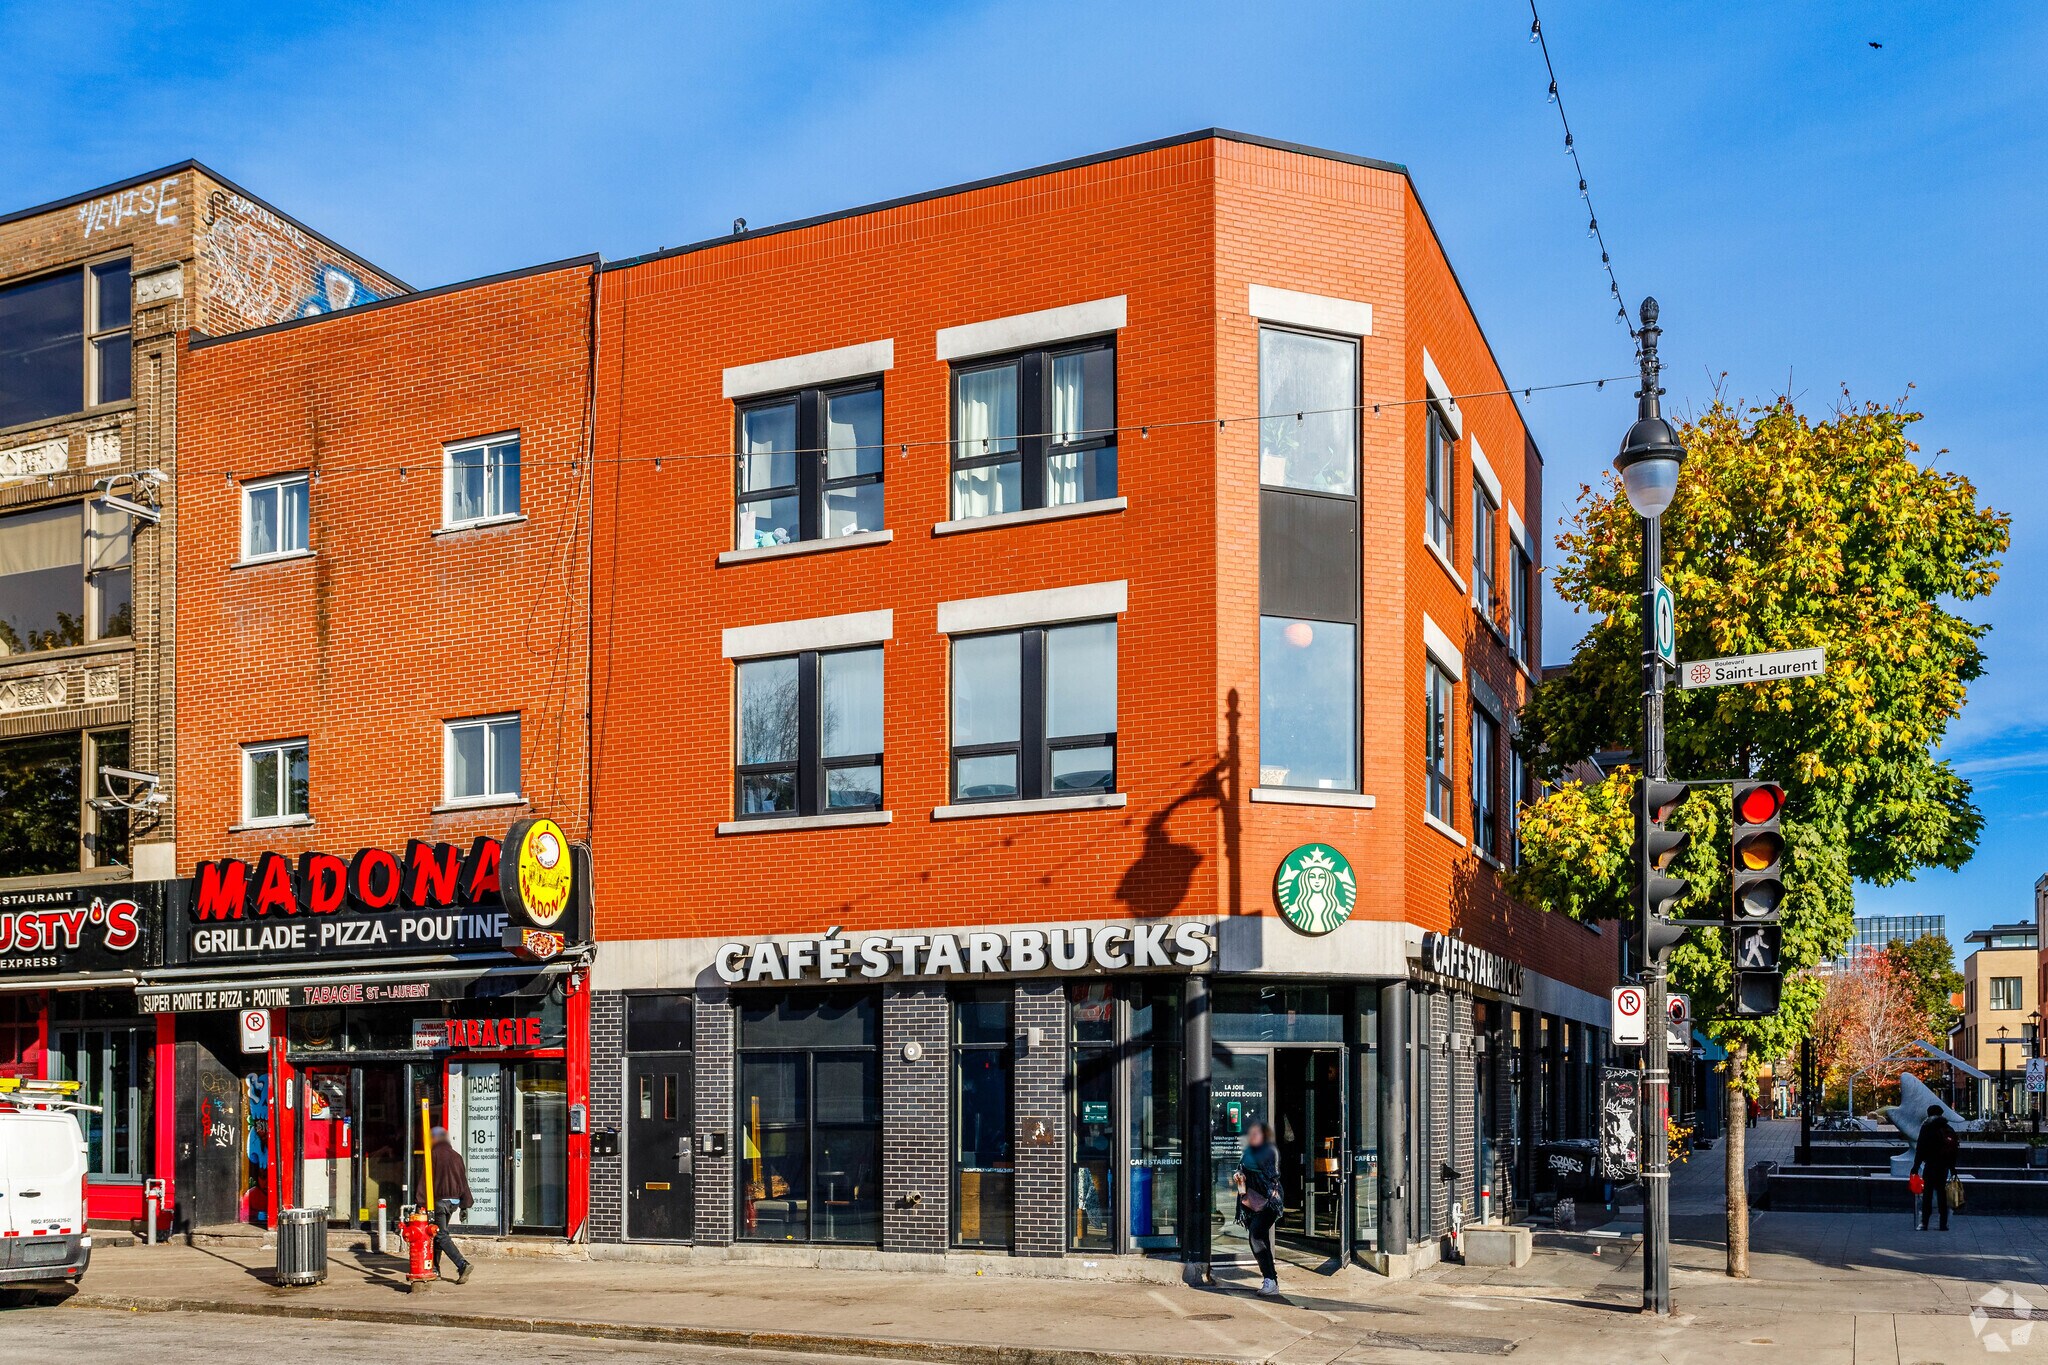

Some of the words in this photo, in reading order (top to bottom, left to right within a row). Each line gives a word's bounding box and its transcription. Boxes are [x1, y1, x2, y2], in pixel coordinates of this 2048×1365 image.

[1714, 658, 1745, 667] Boulevard
[1715, 659, 1818, 681] Saint-Laurent
[521, 873, 567, 919] MADONA
[194, 923, 306, 954] GRILLADE
[320, 919, 388, 947] PIZZA
[400, 911, 508, 943] POUTINE
[0, 956, 58, 969] EXPRESS
[715, 926, 850, 983] CAFÉ
[859, 921, 1216, 979] STARBUCKS
[1433, 928, 1465, 979] CAFÉ
[1466, 944, 1525, 998] STARBUCKS
[143, 994, 170, 1013] SUPER
[172, 992, 203, 1012] POINTE
[205, 991, 217, 1009] DE
[219, 990, 243, 1009] PIZZA
[253, 988, 290, 1007] POUTINE
[303, 984, 363, 1005] TABAGIE
[366, 983, 431, 999] ST-LAURENT
[445, 1017, 542, 1047] TABAGIE
[468, 1075, 500, 1094] TABAGIE
[468, 1105, 493, 1113] Toujours
[1148, 1158, 1182, 1166] STARBUC
[1354, 1153, 1371, 1162] CAFÉ
